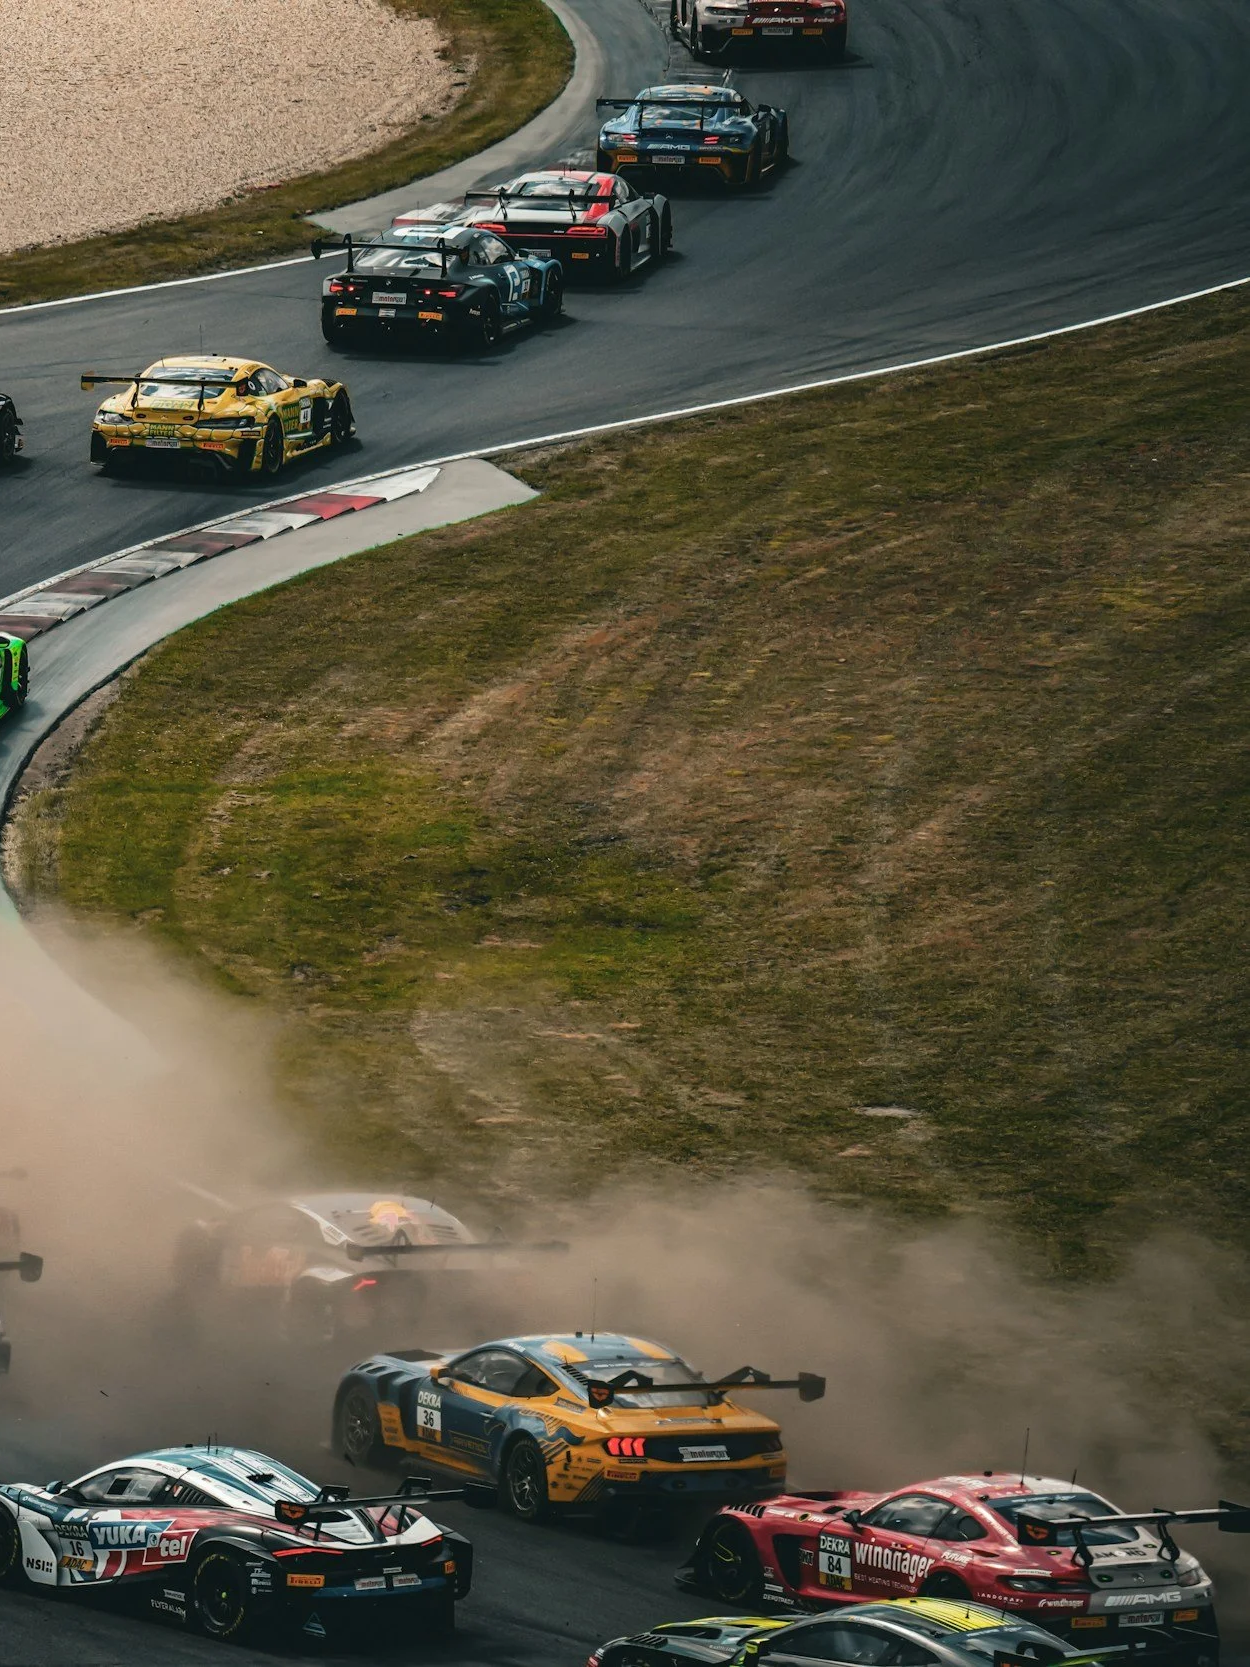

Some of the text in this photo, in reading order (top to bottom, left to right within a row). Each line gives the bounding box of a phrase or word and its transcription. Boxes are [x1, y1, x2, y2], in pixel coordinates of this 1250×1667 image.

[417, 1390, 441, 1408] DEKRA
[423, 1410, 435, 1427] 36
[606, 1469, 638, 1479] PIRELLI
[55, 1524, 88, 1539] DEKRA
[93, 1525, 147, 1545] YUKA
[69, 1540, 85, 1557] 16
[159, 1535, 186, 1558] tel
[819, 1535, 851, 1554] DEKRA
[64, 1556, 88, 1570] ADAC
[827, 1555, 842, 1574] 84
[941, 1551, 973, 1564] FUTURE
[290, 1576, 322, 1585] PIRELLI
[1046, 1598, 1084, 1609] windhager
[1131, 1591, 1182, 1605] AMG
